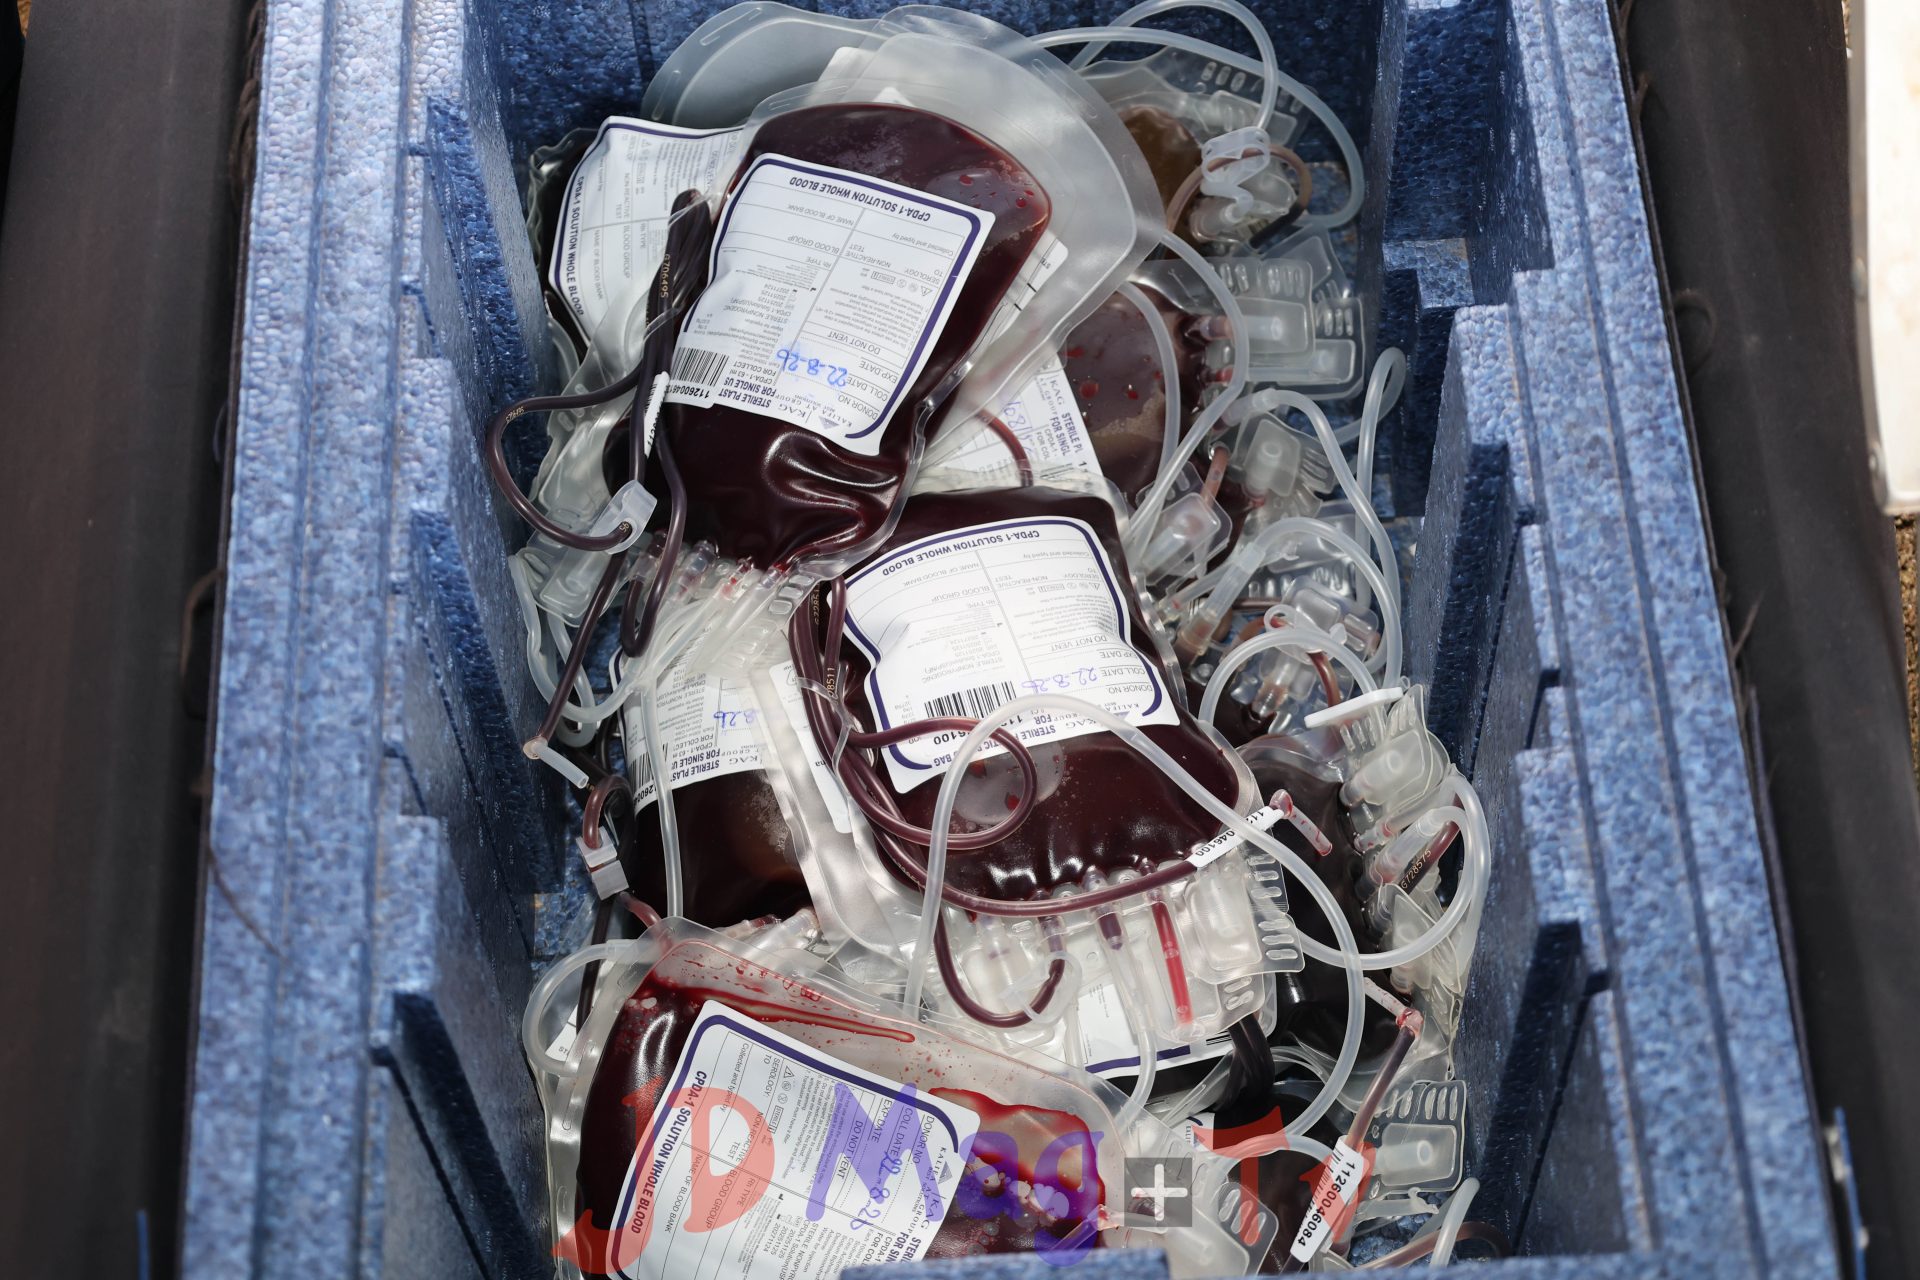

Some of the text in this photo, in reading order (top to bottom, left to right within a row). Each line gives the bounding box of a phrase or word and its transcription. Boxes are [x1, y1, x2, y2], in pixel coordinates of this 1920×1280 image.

[786, 204, 804, 212] BANK
[789, 176, 930, 221] CPDA-1 SOLUTION WHOLE BLOOD
[804, 208, 825, 218] BLOOD
[835, 216, 853, 226] NAME
[569, 206, 580, 253] SOLUTION
[891, 232, 900, 240] by
[899, 235, 915, 244] typed
[787, 235, 839, 254] BLOOD GROUP
[926, 243, 953, 256] Collected
[566, 252, 576, 283] WHOLE
[806, 256, 821, 265] TYPE
[848, 243, 943, 277] TO TEST
[568, 285, 584, 315] BLOOD
[764, 313, 787, 323] STERILE
[827, 330, 880, 354] DO NOT VENT
[749, 373, 772, 384] CPDA-1
[762, 367, 776, 376] FOR
[723, 376, 776, 397] FOR SINGLE US
[1049, 379, 1064, 405] KAG
[717, 388, 771, 407] STERILE PLAST
[774, 393, 801, 405] GROUP
[779, 403, 806, 417] KAG
[822, 409, 852, 427] KALIFA
[851, 400, 878, 420] DONOR
[1035, 431, 1044, 444] FOR
[1049, 416, 1070, 456] FOR SINGL
[1061, 412, 1079, 442] STERILE
[882, 530, 1039, 575] CPDA-1 SOLUTION WHOLE BLOOD
[931, 585, 989, 602] BLOOD GROUP
[968, 600, 984, 608] TYPE
[1050, 641, 1071, 651] VENT
[1075, 636, 1091, 645] NOT
[1033, 714, 1050, 723] FOR
[700, 733, 713, 741] FOR
[933, 715, 1022, 744] 116100
[1020, 724, 1055, 739] STERILE
[679, 748, 720, 767] FOR SINGLE
[690, 741, 712, 753] CPDA-1
[672, 759, 719, 780] STERILE PLAS
[729, 755, 757, 764] KAG
[933, 754, 951, 766] BAG
[719, 1042, 749, 1112] Collected and typed by
[727, 1054, 772, 1159] TO TEST
[917, 1115, 934, 1148] DONOR
[631, 1070, 707, 1233] CPDA-1 SOLUTION WHOLE BLOOD
[836, 1120, 863, 1179] DO NOT VENT
[664, 1153, 703, 1232] NAME OF BLOOD BANK
[705, 1169, 737, 1228] BLOOD GROUP
[736, 1177, 755, 1207] Rh TYPE
[907, 1147, 946, 1233] KALIFA AT GROUP
[920, 1198, 939, 1229] KAG
[1298, 1162, 1354, 1245] 11260046084
[762, 1222, 780, 1251] 20271124
[770, 1225, 788, 1255] 20251125
[794, 1219, 810, 1242] CPDA-1
[801, 1222, 818, 1249] STERILE
[870, 1232, 883, 1247] FOR
[778, 1228, 796, 1258] 20251125
[874, 1236, 892, 1261] CPDA-1
[885, 1231, 909, 1262] FOR SIN
[902, 1236, 921, 1260] STERI
